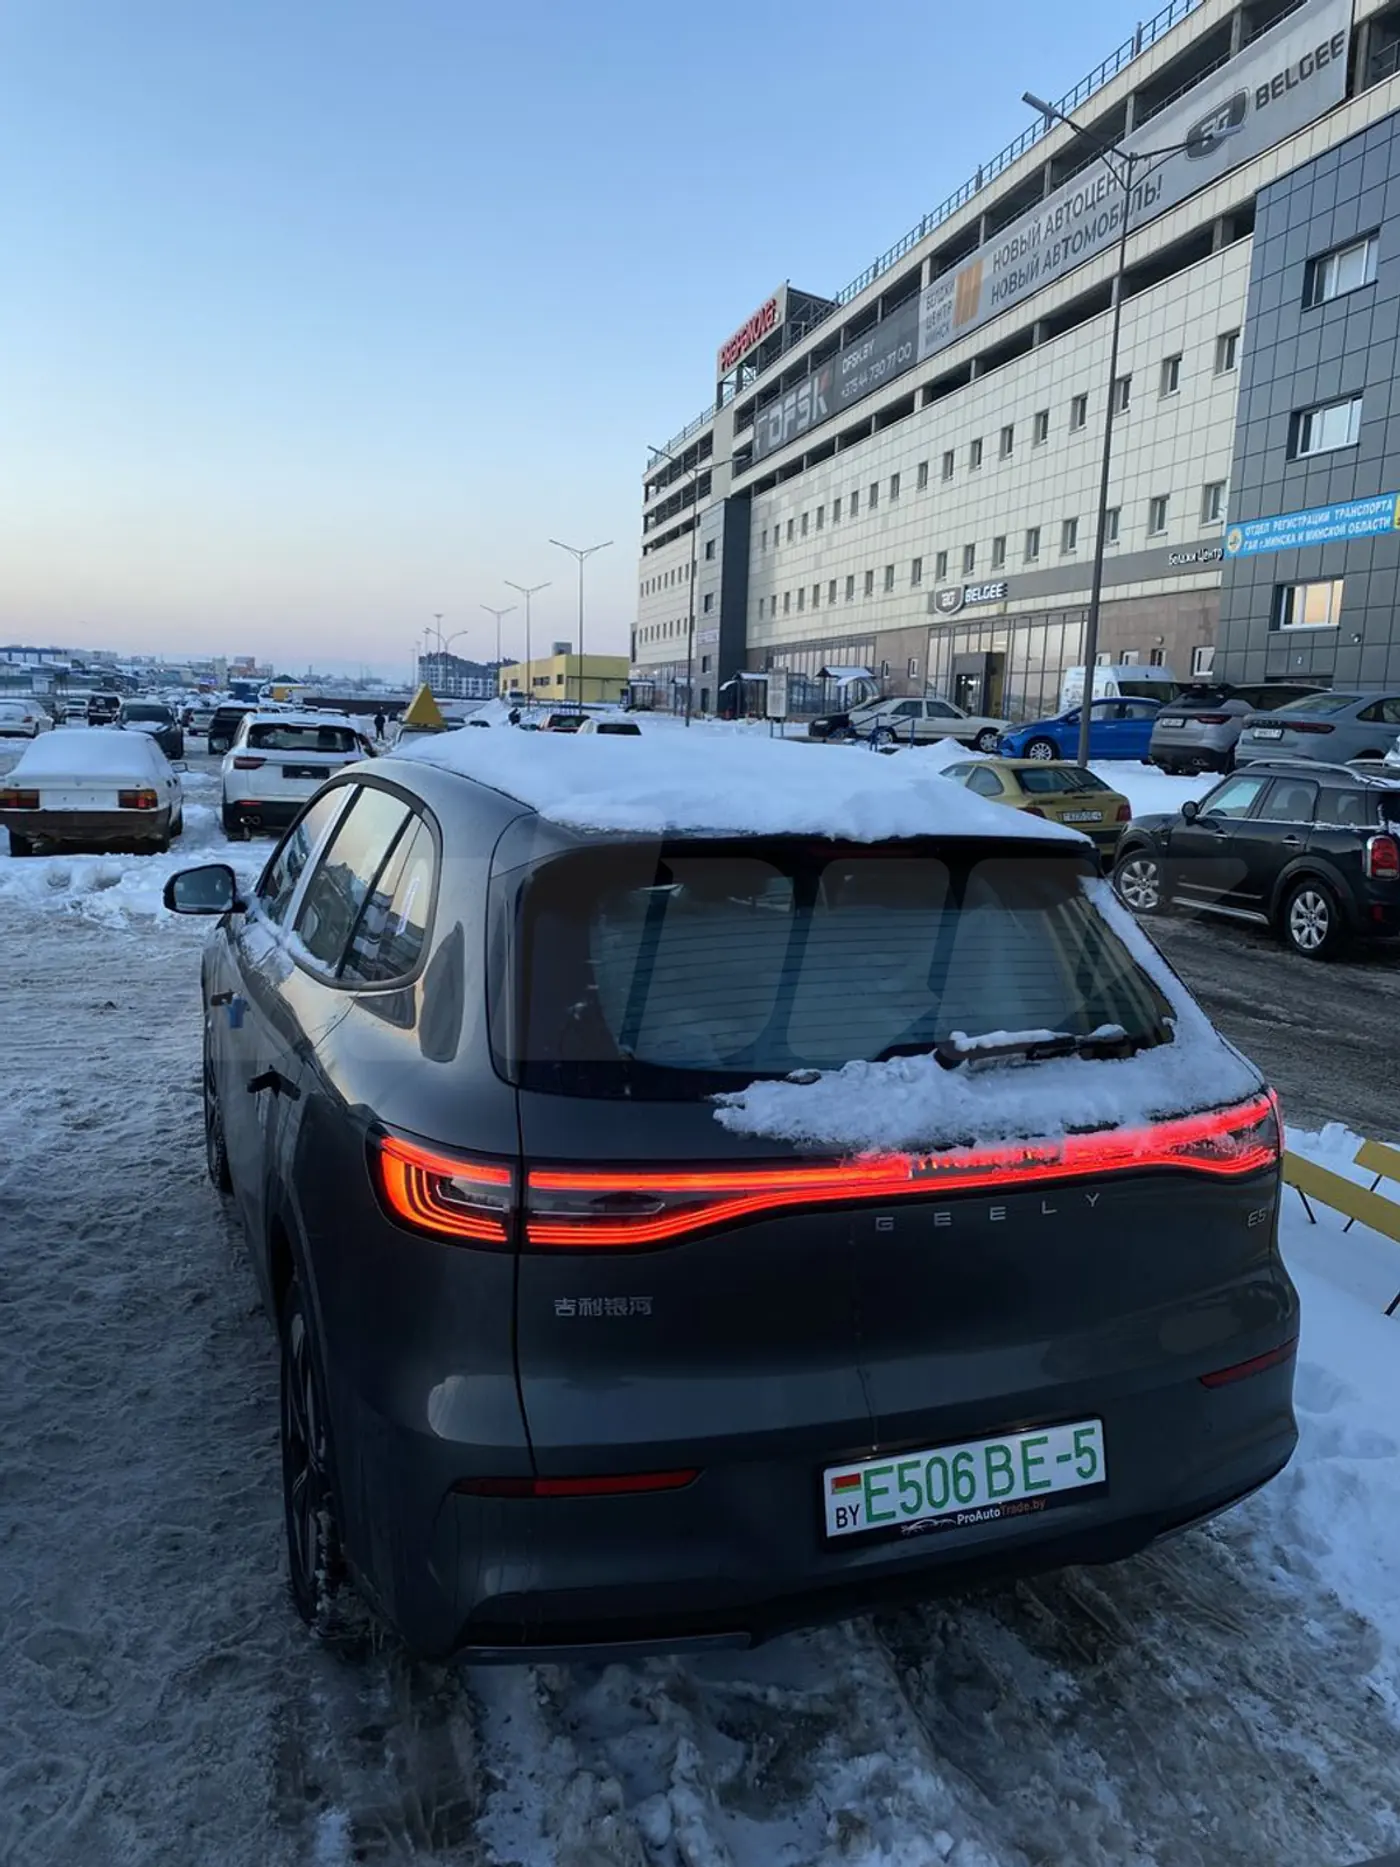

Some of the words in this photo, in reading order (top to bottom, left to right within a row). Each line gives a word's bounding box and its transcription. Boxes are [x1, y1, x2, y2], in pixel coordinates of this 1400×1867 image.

[1255, 29, 1346, 111] BELGEE
[992, 216, 1041, 275] НОВЫЙ
[991, 253, 1041, 306] НОВЫЙ
[1244, 522, 1270, 537] ОТДЕЛ
[1273, 511, 1330, 532] РЕГИСТРАЦИИ
[1334, 499, 1393, 520] ТРАНСПОРТА
[1306, 523, 1347, 542] МИНСКОЙ
[1348, 516, 1391, 533] ОБЛАСТИ
[965, 582, 1004, 603] BELGEE
[875, 1192, 1101, 1231] GEELY
[554, 1296, 653, 1316] 吉利银河
[835, 1503, 861, 1529] BY
[956, 1500, 1046, 1525] ProAutoTrade.by
